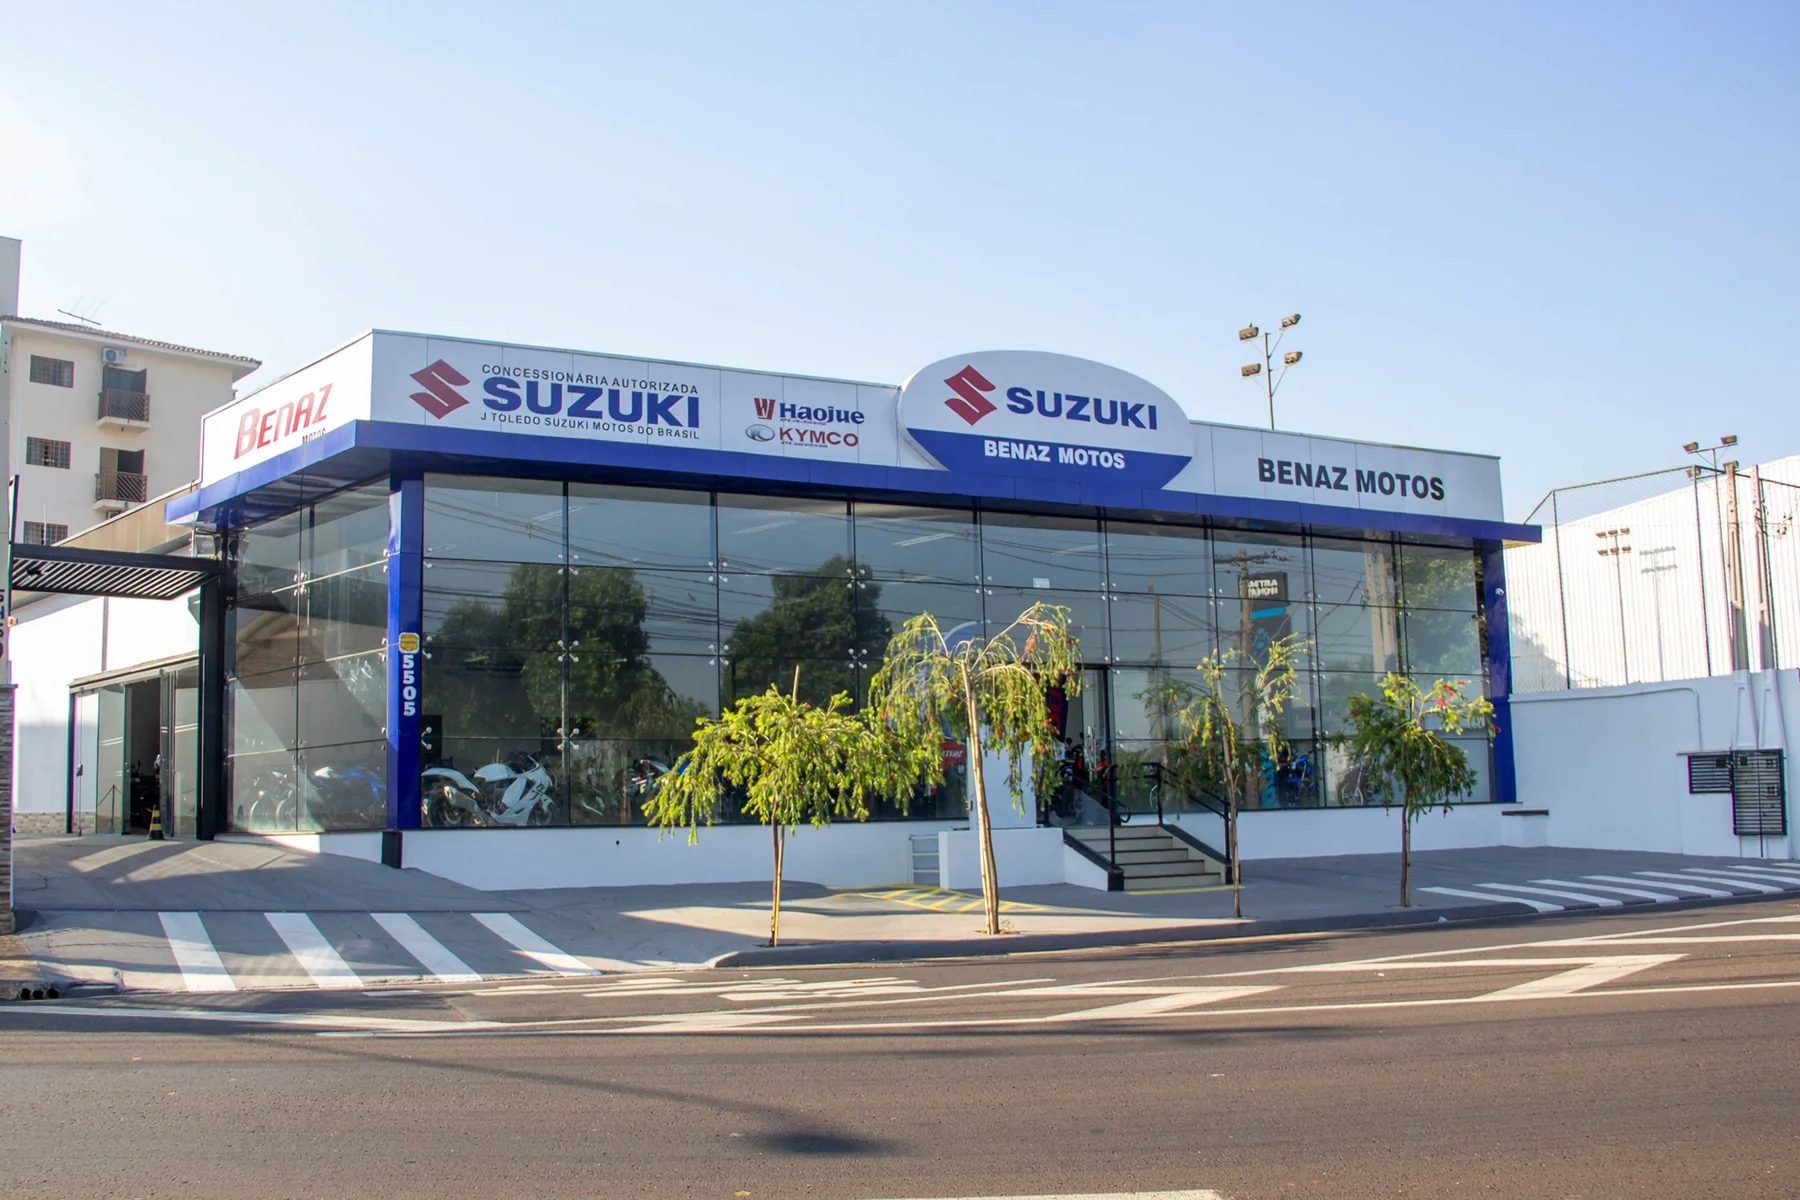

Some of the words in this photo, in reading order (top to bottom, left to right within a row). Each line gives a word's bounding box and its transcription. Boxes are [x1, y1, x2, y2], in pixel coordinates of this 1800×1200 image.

[612, 377, 699, 394] AUTORIZADA
[482, 376, 700, 428] SUZUKI
[779, 402, 865, 425] Haojue
[1006, 386, 1158, 430] SUZUKI
[480, 412, 487, 421] J
[491, 412, 541, 426] TOLEDO
[544, 417, 589, 430] SUZUKI
[592, 421, 634, 434] MOTOS
[637, 426, 654, 436] DO
[657, 427, 700, 440] BRASIL
[779, 427, 859, 447] KYMCO
[984, 439, 1051, 462] BENAZ
[1058, 446, 1126, 470] MOTOS
[1257, 457, 1349, 491] BENAZ
[1355, 469, 1445, 501] MOTOS
[402, 654, 417, 716] 5505
